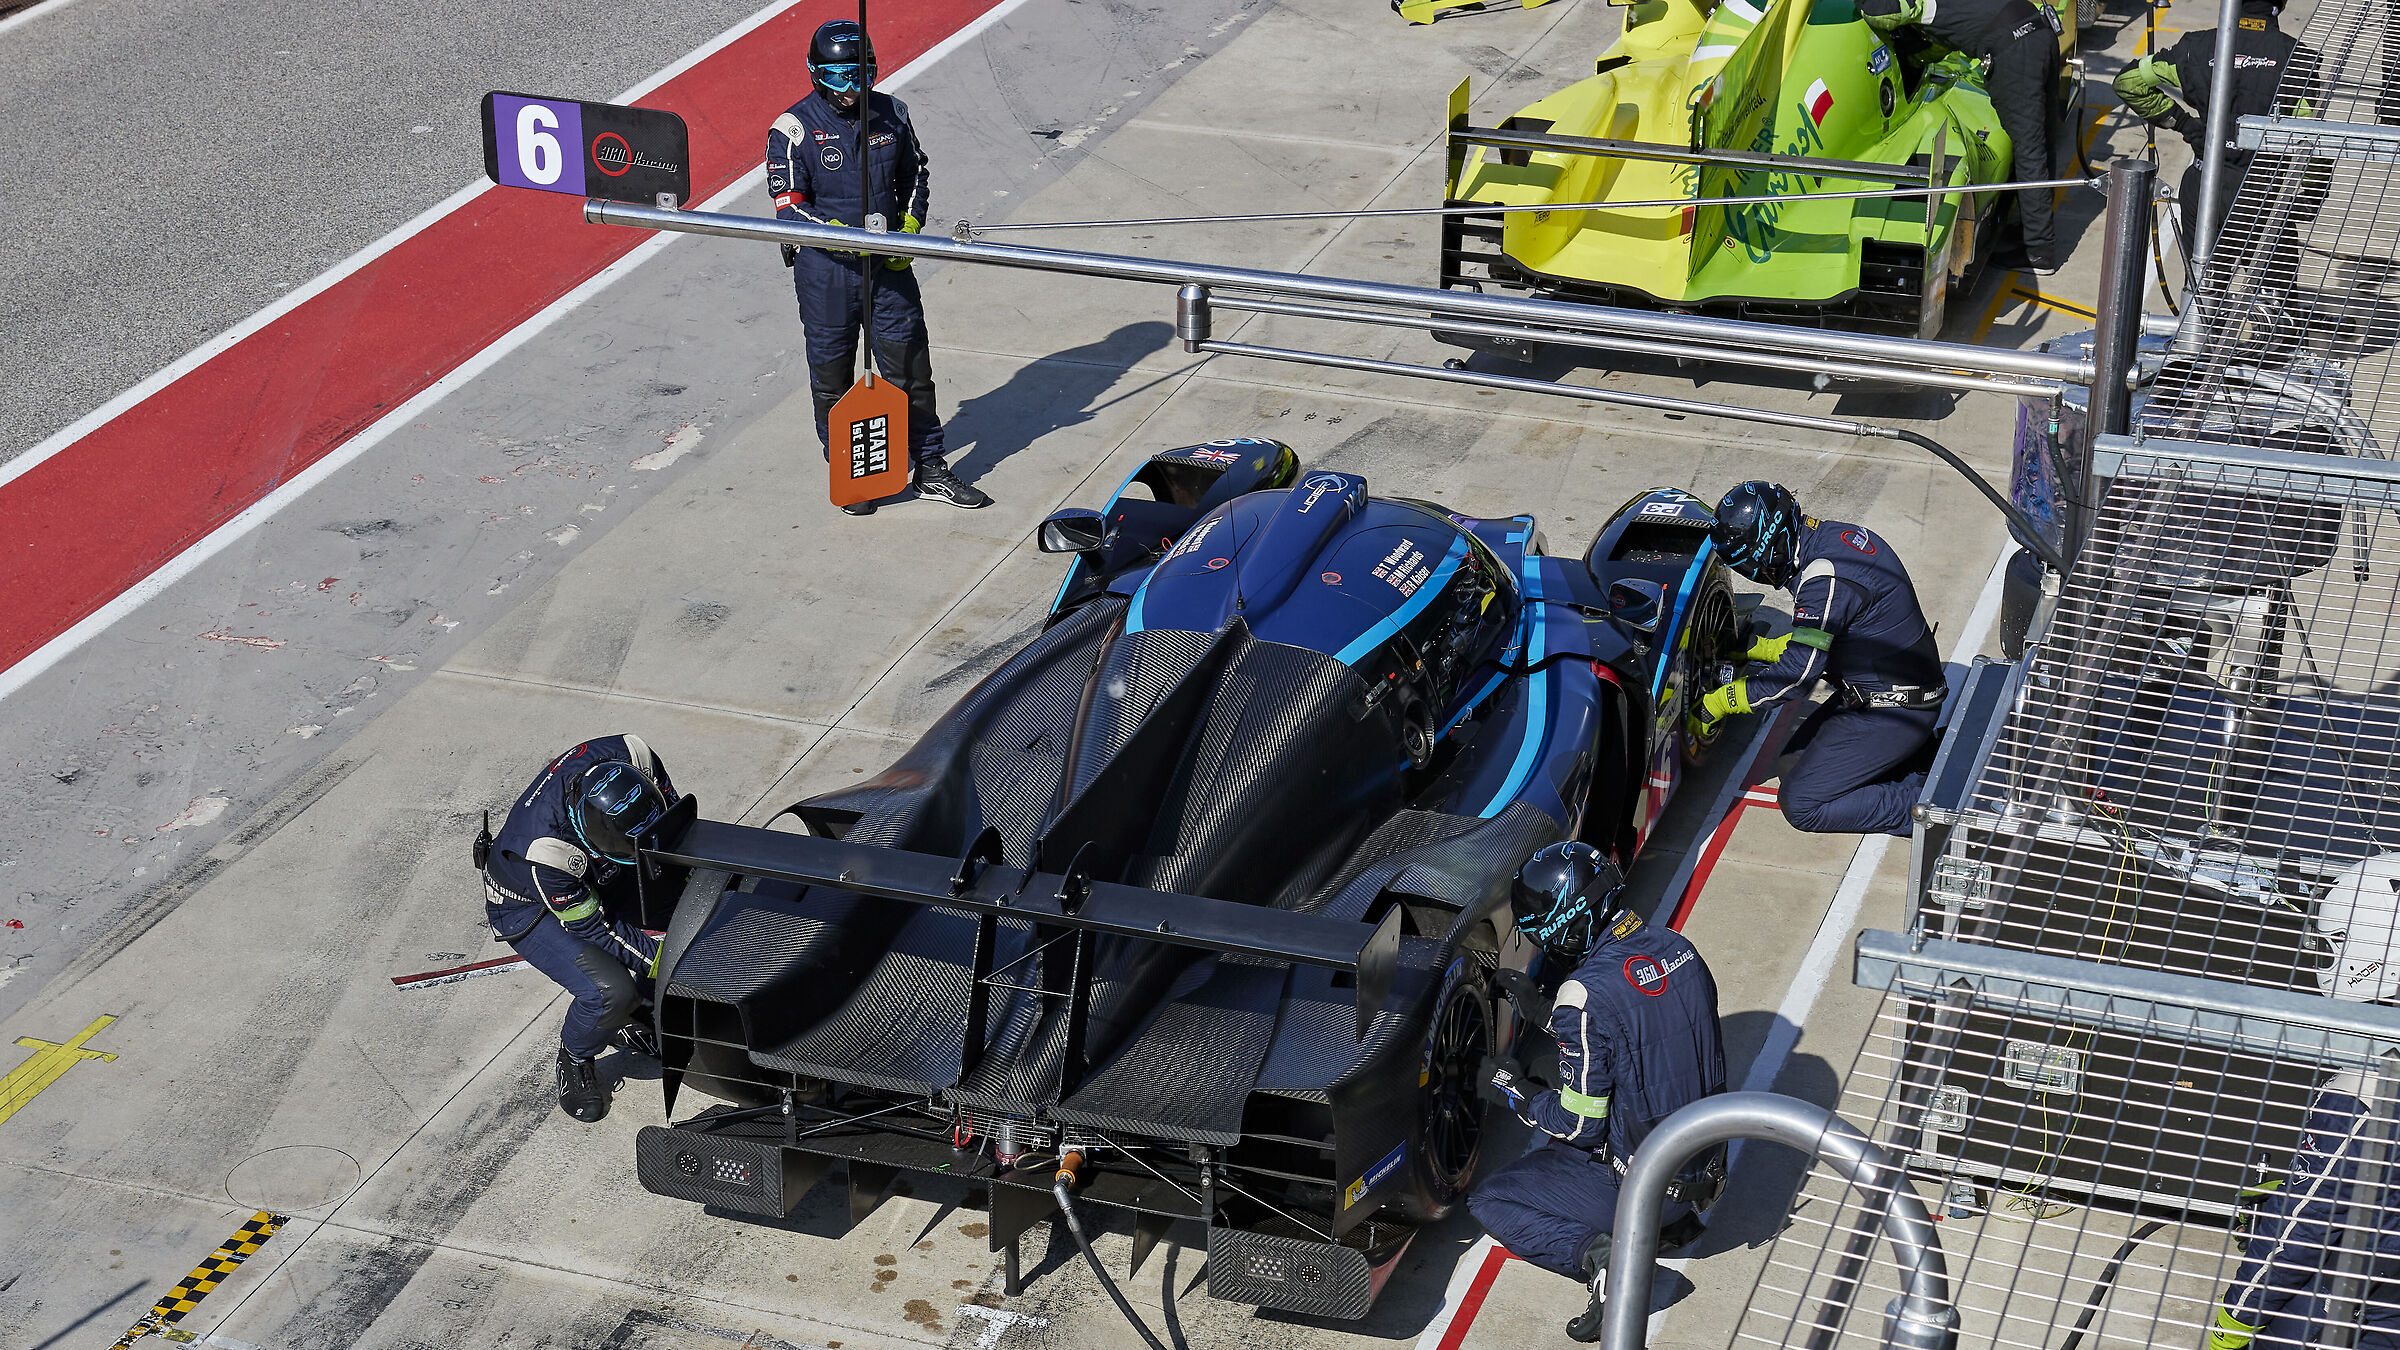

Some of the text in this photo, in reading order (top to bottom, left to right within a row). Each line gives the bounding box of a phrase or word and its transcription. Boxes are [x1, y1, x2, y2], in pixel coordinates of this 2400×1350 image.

[517, 104, 562, 185] 6
[629, 150, 678, 173] Racing
[852, 421, 866, 477] 1st GEAR
[868, 416, 887, 472] START
[1378, 562, 1391, 571] T
[1662, 948, 1695, 977] Racing
